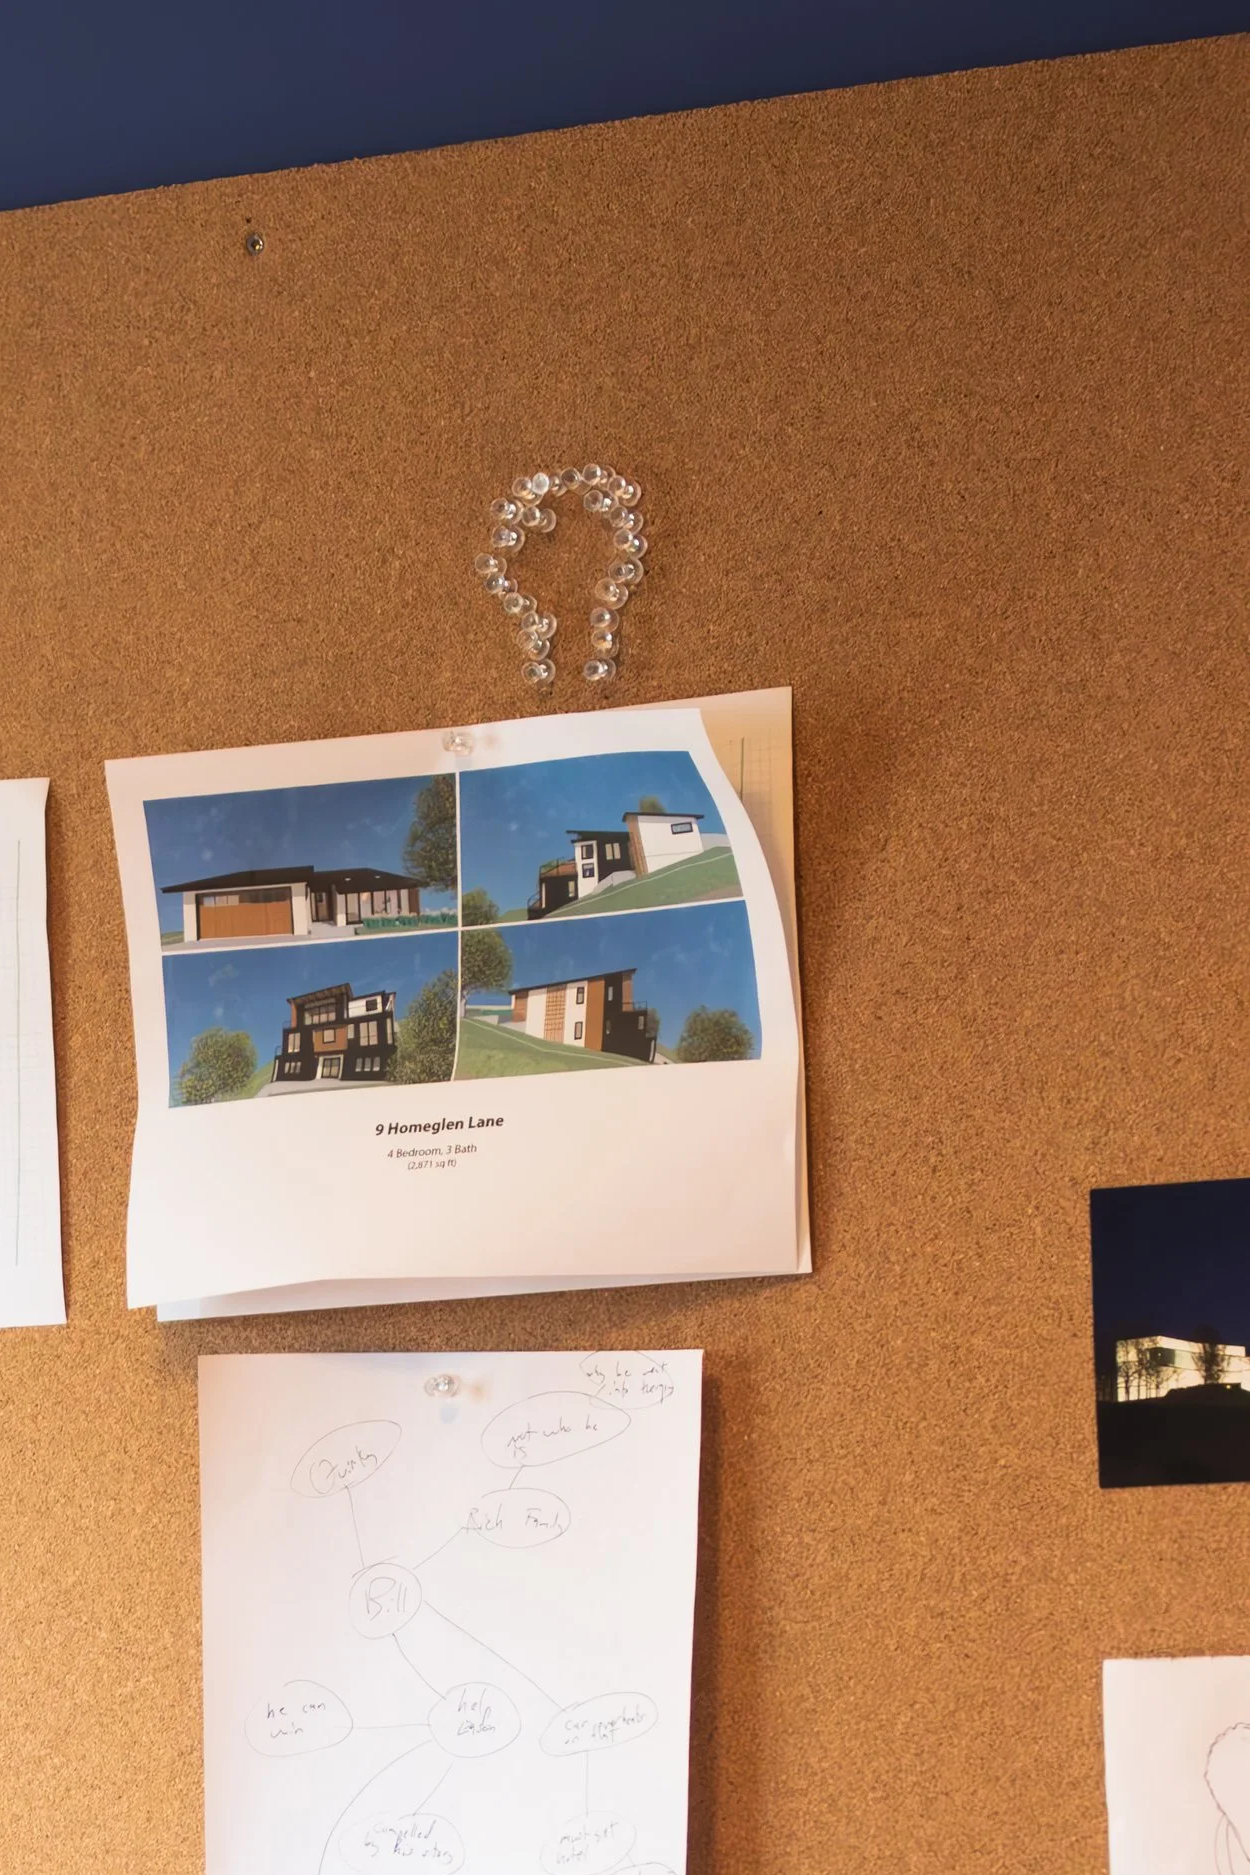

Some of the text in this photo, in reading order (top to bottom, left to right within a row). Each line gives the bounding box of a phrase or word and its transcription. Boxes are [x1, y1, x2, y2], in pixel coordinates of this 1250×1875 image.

[375, 1116, 504, 1136] 9 Homeglen Lane
[387, 1143, 477, 1158] 4 Bedroom, 3 Bath
[407, 1158, 457, 1170] (2,871 sq ft)
[585, 1413, 598, 1431] he
[364, 1576, 408, 1622] Bill
[266, 1702, 326, 1720] he can
